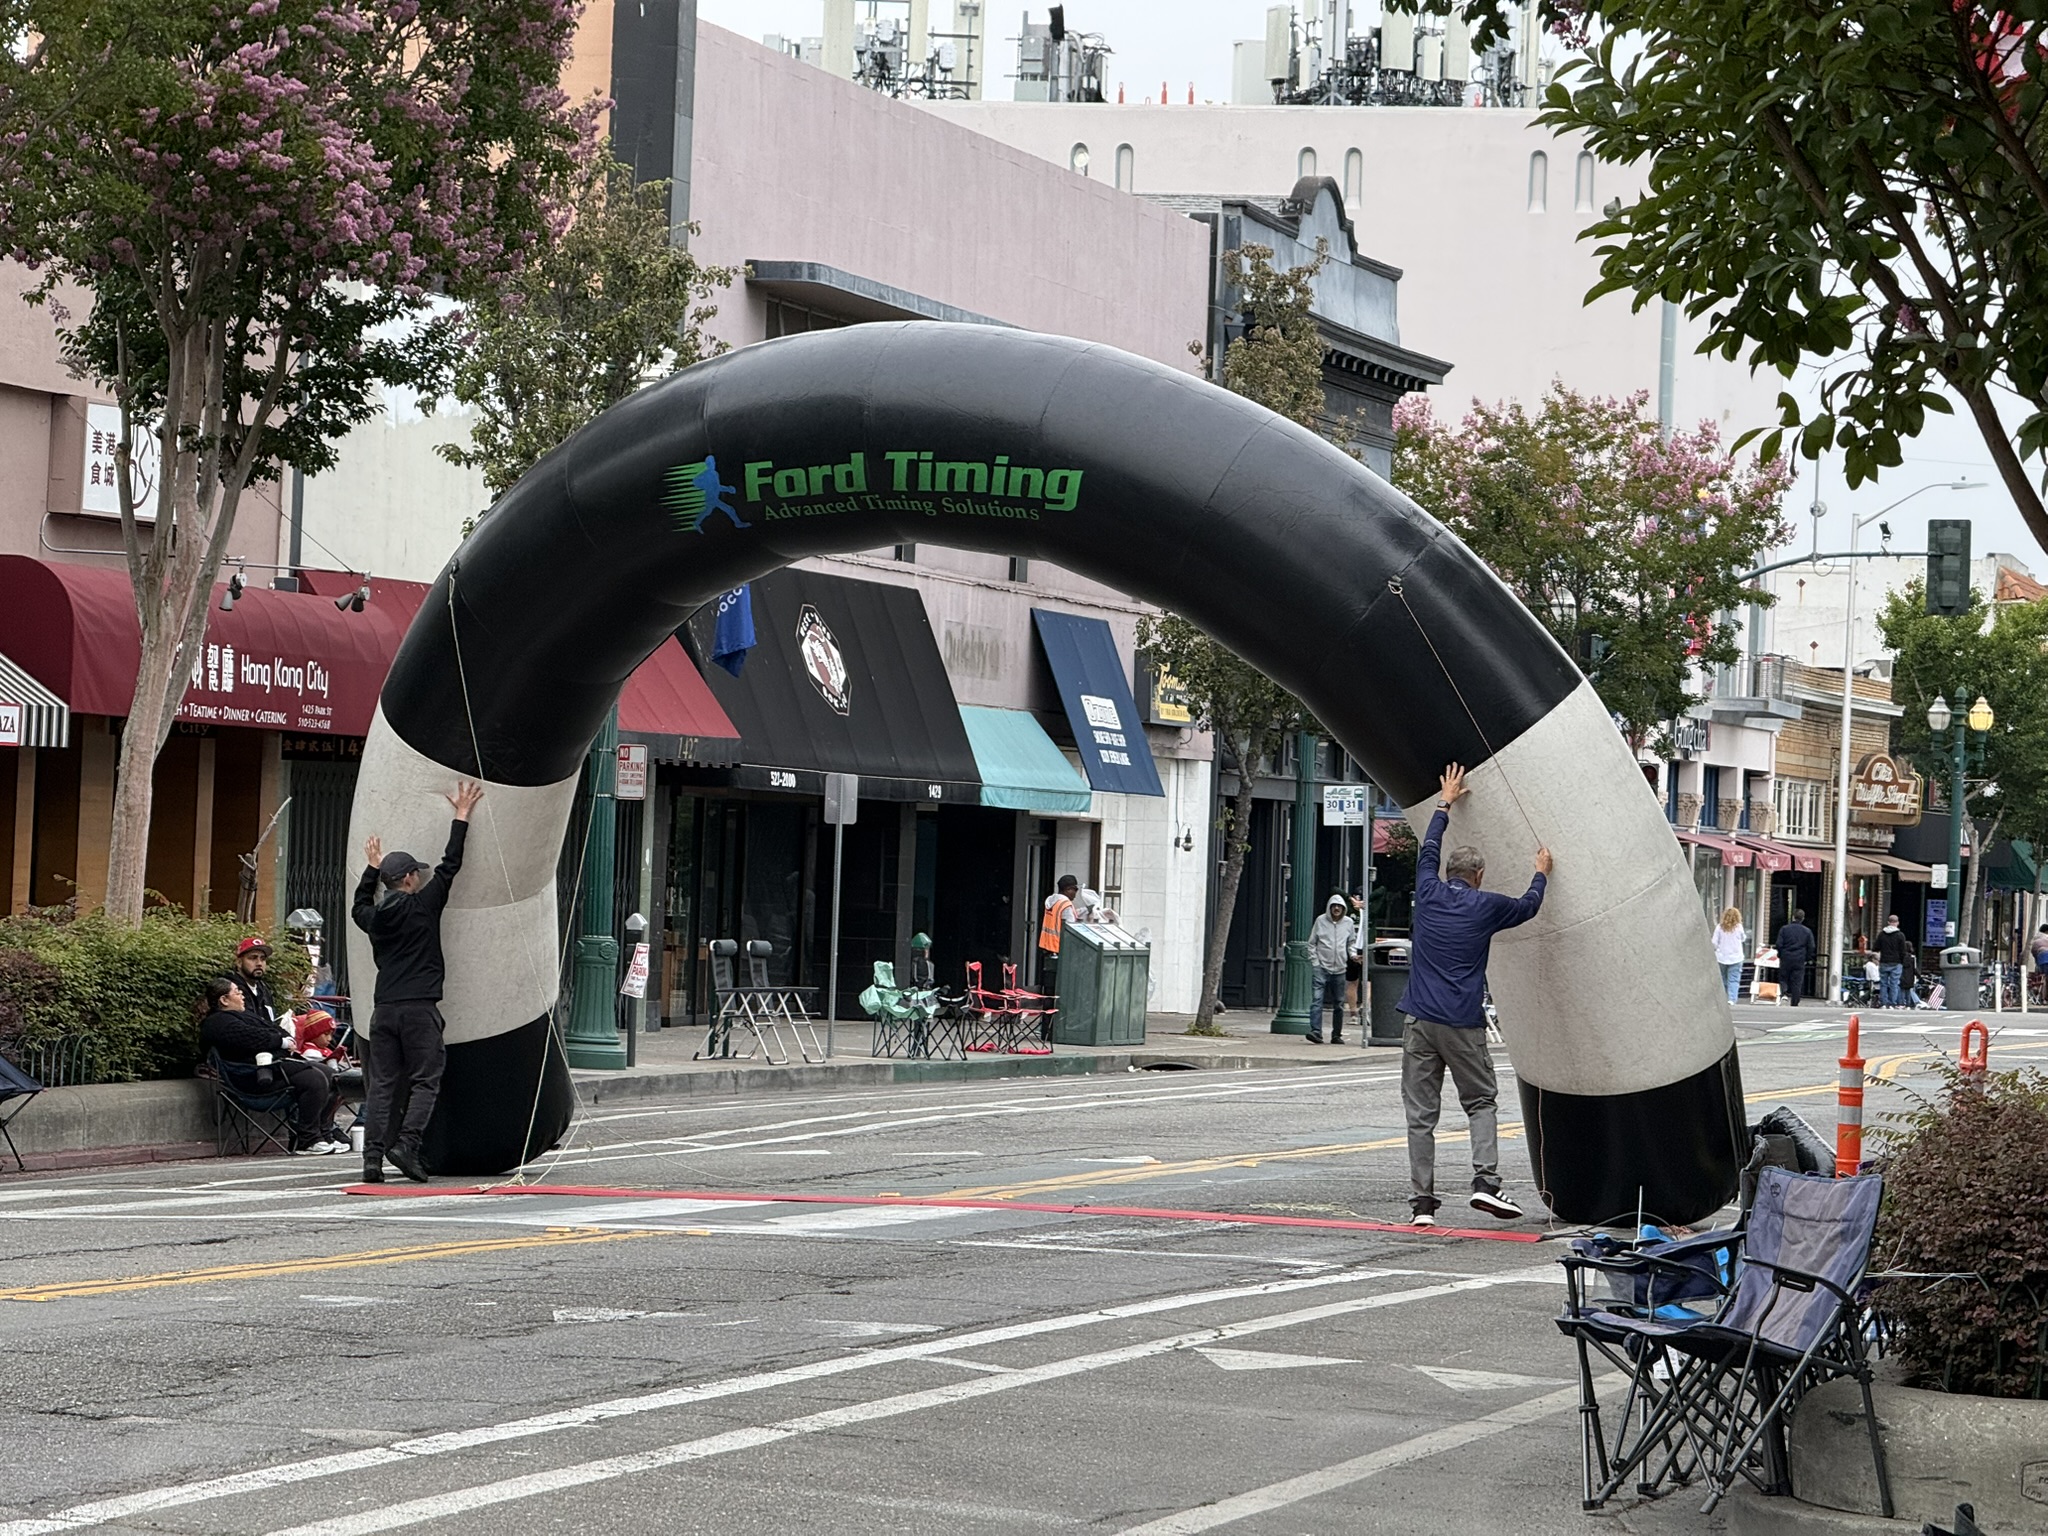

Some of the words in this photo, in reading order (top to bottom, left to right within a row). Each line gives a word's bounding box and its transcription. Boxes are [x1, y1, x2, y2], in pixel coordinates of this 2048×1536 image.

[90, 430, 103, 486] 美食
[744, 452, 866, 502] Ford
[884, 451, 1084, 512] Timing
[764, 497, 858, 521] Advanced
[865, 495, 937, 516] Timing
[942, 497, 1040, 520] Solutions
[241, 654, 270, 694] Hong
[274, 657, 302, 696] Kong
[307, 660, 329, 698] City
[0, 715, 16, 733] ZA
[189, 703, 218, 719] TEATIME
[223, 705, 250, 722] DINNER
[255, 709, 287, 725] CATERING
[619, 747, 629, 759] NO
[619, 761, 644, 773] PARKING
[1326, 800, 1338, 809] 30
[1345, 800, 1356, 809] 31
